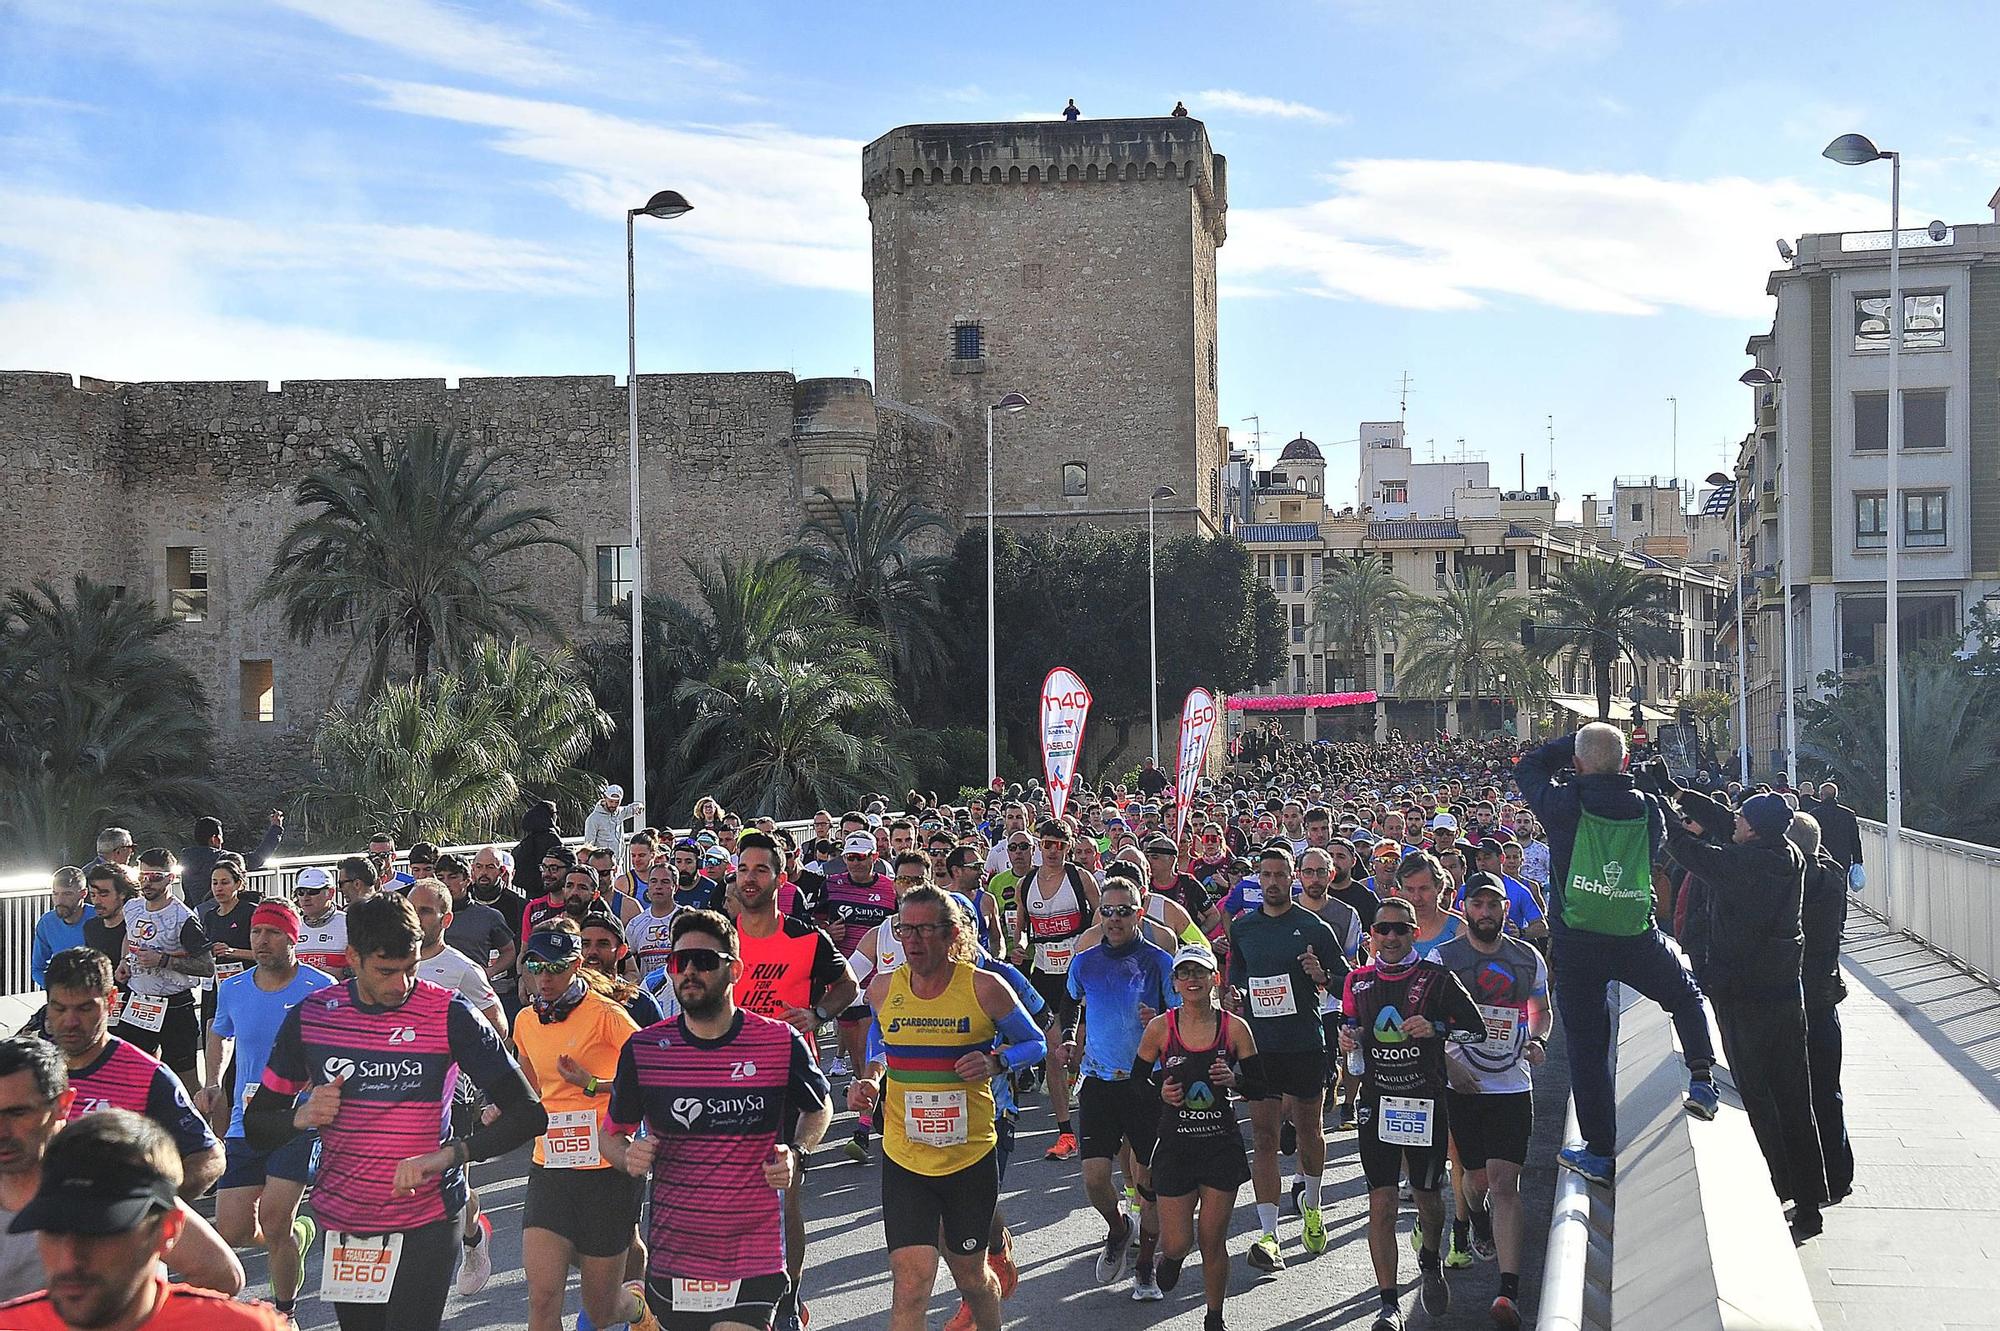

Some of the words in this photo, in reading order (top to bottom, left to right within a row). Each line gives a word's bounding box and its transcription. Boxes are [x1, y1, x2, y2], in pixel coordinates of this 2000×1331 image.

[1572, 875, 1611, 895] Elche
[750, 963, 789, 980] RUN
[740, 990, 777, 1006] LIFE
[1257, 995, 1284, 1007] 1017
[131, 1009, 156, 1022] 1125
[887, 1016, 956, 1033] SCARBOROUGH
[358, 1059, 423, 1081] SanySa
[706, 1094, 765, 1115] SanySa
[916, 1119, 955, 1134] 1231
[1386, 1120, 1425, 1134] 1503
[549, 1138, 590, 1153] 1059
[333, 1264, 386, 1283] 1260
